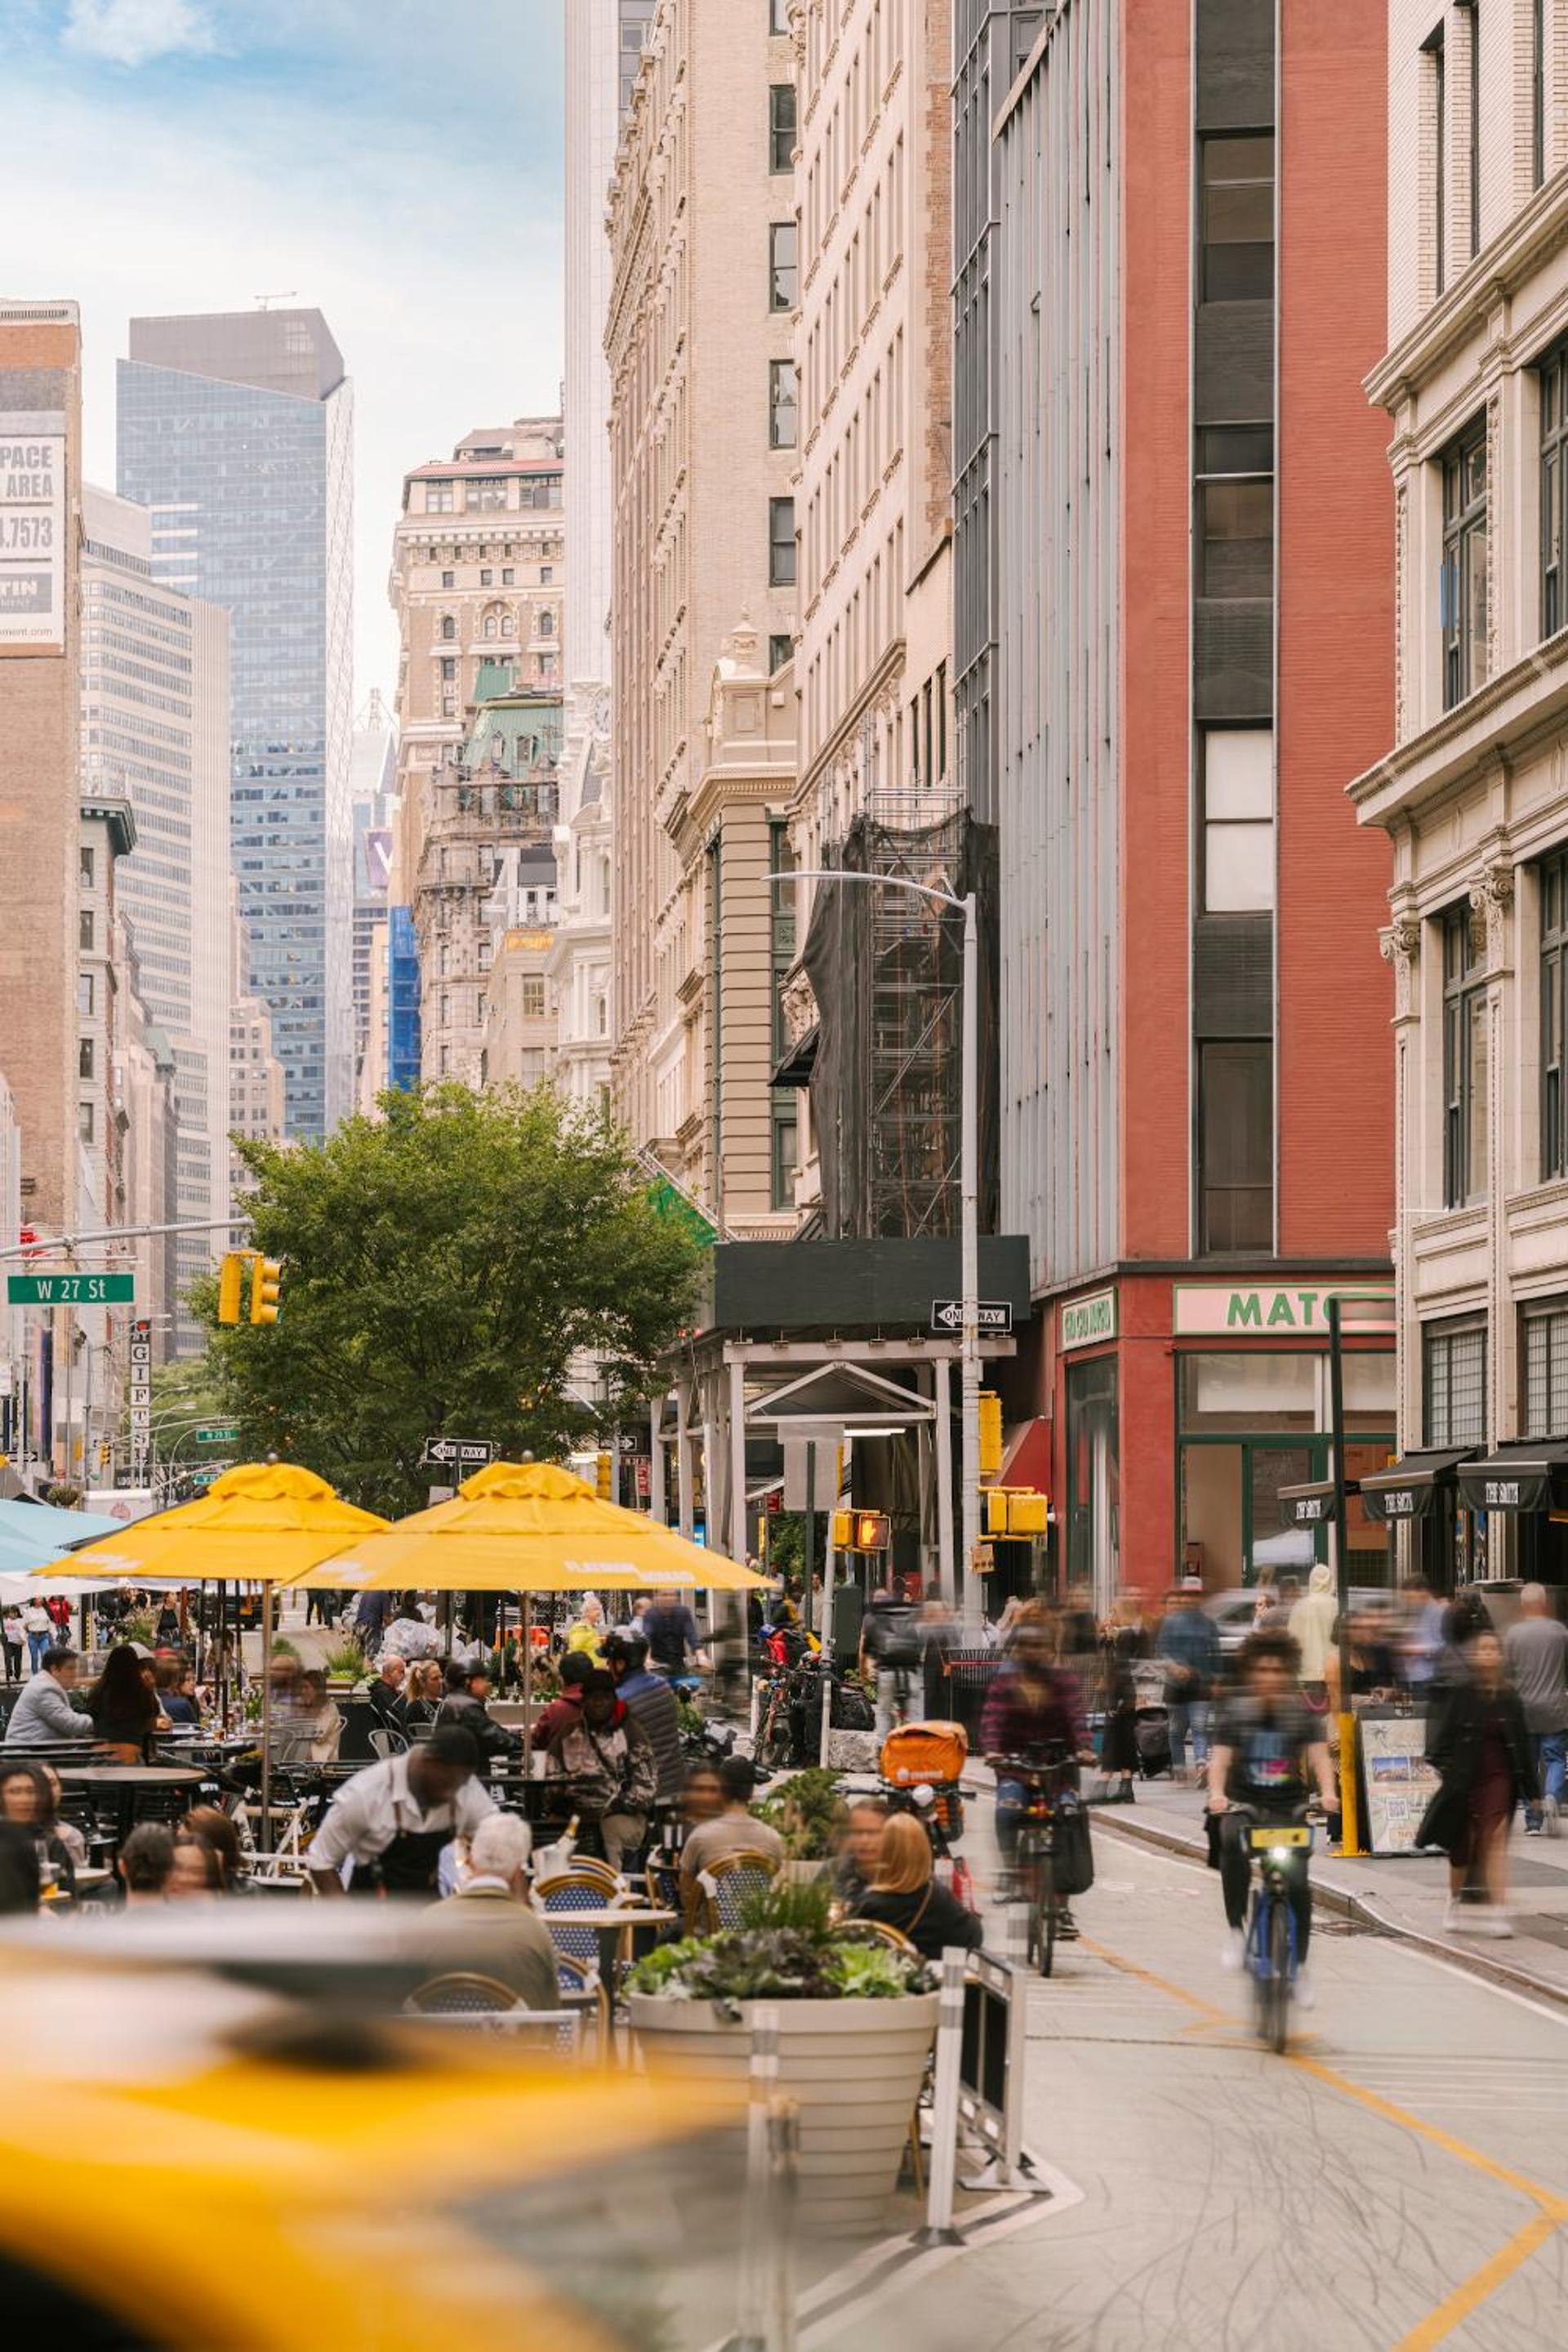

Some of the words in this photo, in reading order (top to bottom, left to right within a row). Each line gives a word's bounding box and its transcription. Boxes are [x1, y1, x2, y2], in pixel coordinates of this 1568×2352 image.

[7, 474, 52, 497] AREA
[37, 1280, 52, 1299] W
[60, 1280, 80, 1299] 27
[89, 1279, 106, 1298] St
[945, 1309, 964, 1321] ON
[436, 1446, 455, 1455] ONE
[463, 1448, 483, 1458] WAY
